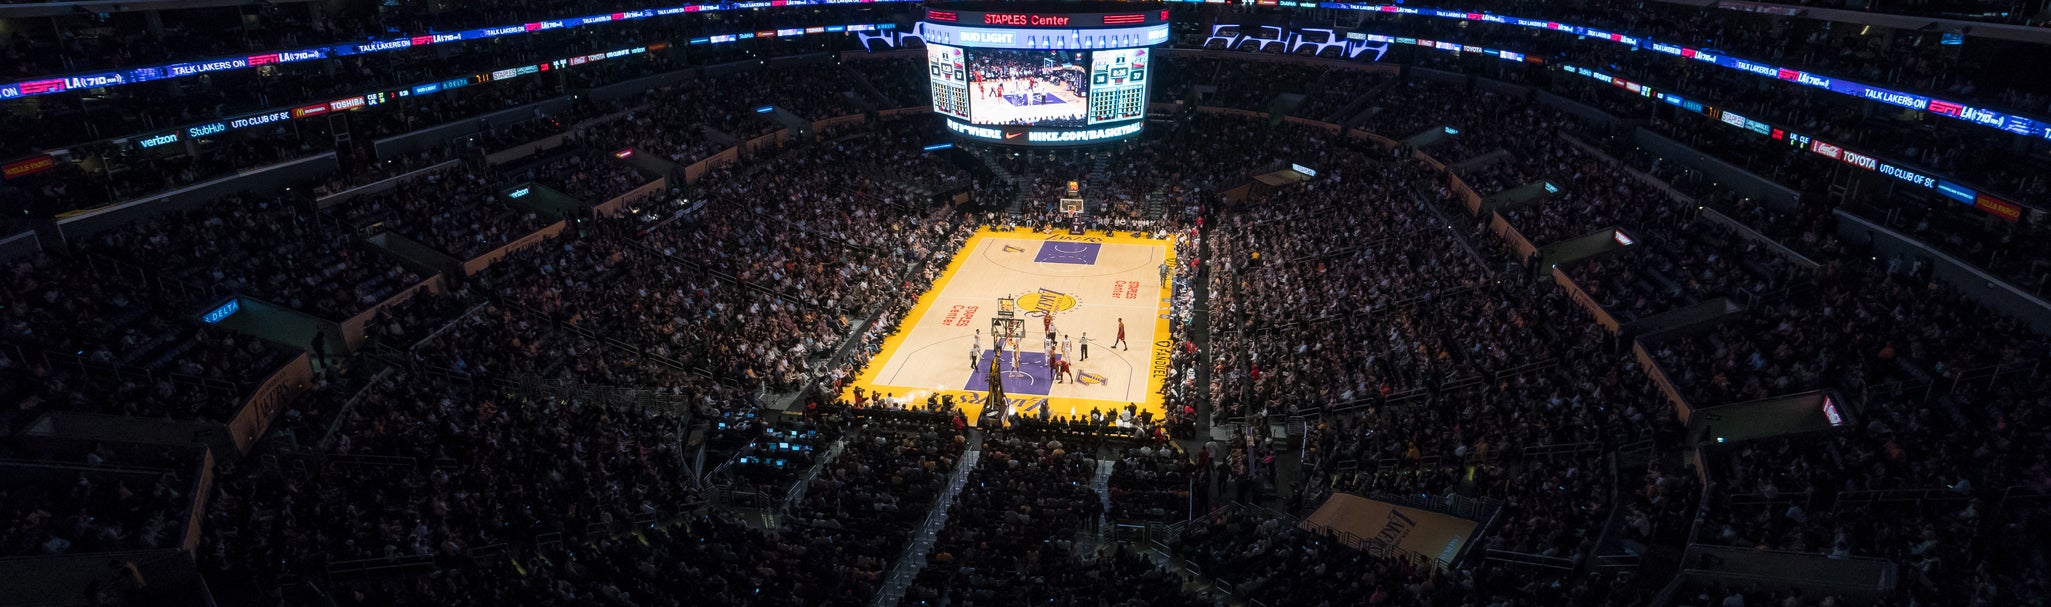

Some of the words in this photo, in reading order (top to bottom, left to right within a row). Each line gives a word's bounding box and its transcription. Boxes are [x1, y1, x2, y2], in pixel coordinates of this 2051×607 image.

[984, 14, 1027, 25] STAPLES
[1031, 15, 1068, 26] Center
[359, 43, 376, 52] TALK
[376, 41, 401, 50] LAKERS
[401, 40, 410, 48] ON
[411, 35, 434, 46] ESPN
[960, 32, 980, 42] BUD
[982, 33, 1015, 44] LIGHT
[588, 54, 605, 62] TOYOTA
[1653, 43, 1661, 51] TALK
[1661, 44, 1675, 54] LAKERS
[1681, 47, 1696, 59] ESPN
[173, 66, 196, 75] TALK
[198, 60, 232, 72] LAKERS
[233, 60, 246, 68] ON
[248, 53, 279, 66] ESPN
[1738, 61, 1750, 71] TALK
[1750, 64, 1769, 76] LAKERS
[1769, 68, 1777, 76] ON
[1778, 67, 1799, 81] ESPN
[4, 87, 18, 97] ON
[20, 79, 65, 94] ESPN
[448, 80, 467, 88] DELTA
[330, 98, 364, 110] TOSHIBA
[1865, 89, 1882, 100] TALK
[1883, 92, 1913, 107] LAKERS
[1914, 98, 1927, 110] ON
[1928, 99, 1962, 116] ESPN
[232, 119, 248, 128] UTO
[249, 116, 269, 126] CLUB
[1722, 111, 1745, 128] STAPLES
[190, 122, 225, 137] StubHub
[1028, 122, 1140, 142] NIKE.COM/BASKETBALL
[140, 134, 177, 148] verizon
[1800, 135, 1809, 144] CLE
[6, 164, 30, 175] WELLS
[30, 159, 52, 170] FARGO
[1843, 151, 1876, 170] TOYOTA
[1879, 164, 1894, 174] UTO
[1894, 168, 1913, 181] CLUB
[1914, 174, 1924, 184] OF
[1977, 197, 1997, 210] WELLS
[1997, 203, 2019, 218] FARGO
[1112, 280, 1126, 298] Center
[1126, 281, 1140, 300] STAPLES
[212, 302, 238, 321] DELTA
[942, 305, 965, 326] Center
[956, 306, 979, 327] STAPLES
[1153, 348, 1170, 378] FANDUEL
